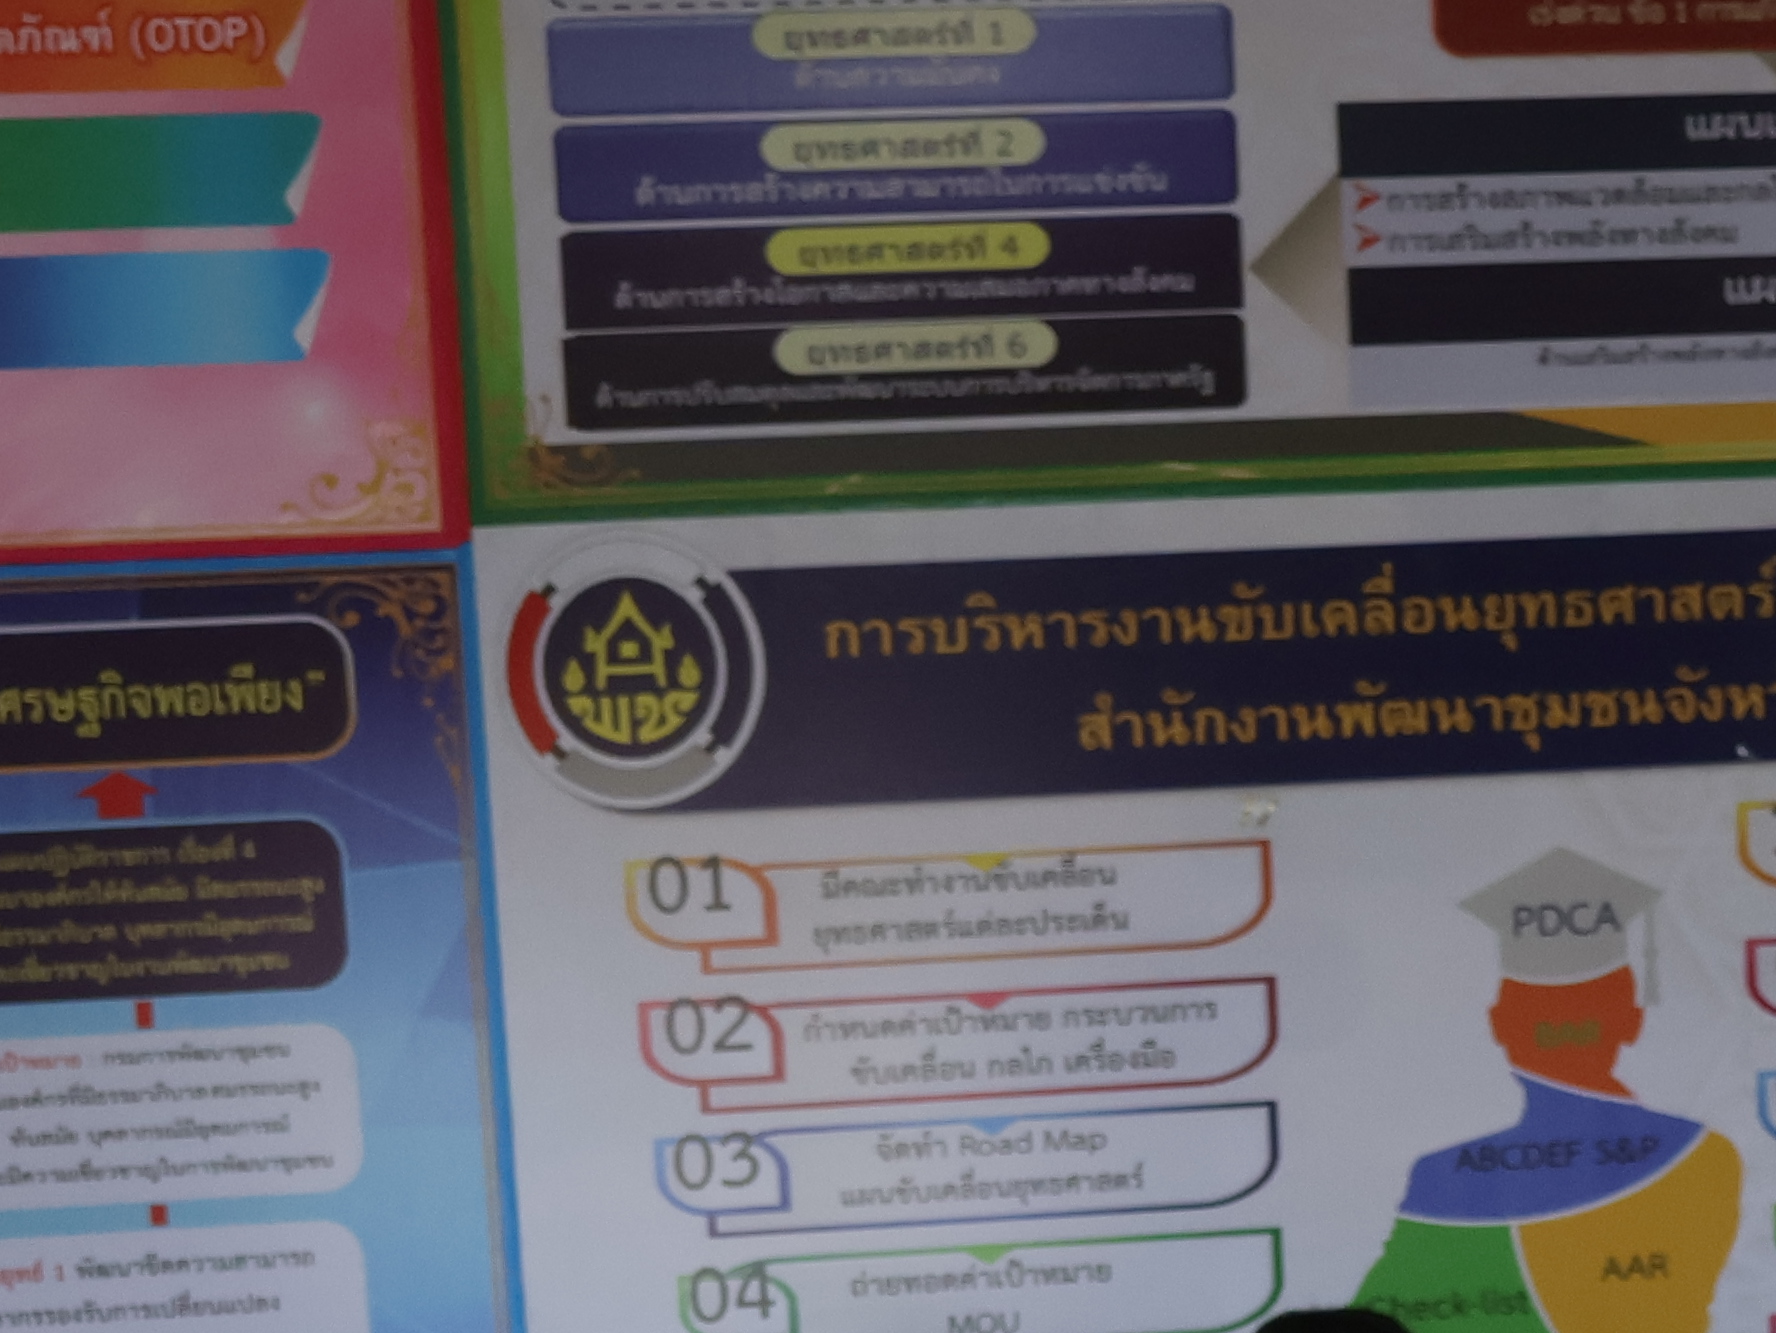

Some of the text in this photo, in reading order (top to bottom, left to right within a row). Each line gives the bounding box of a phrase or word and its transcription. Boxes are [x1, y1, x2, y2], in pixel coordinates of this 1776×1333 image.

[129, 17, 266, 59] (OTOP)
[988, 22, 1005, 47] 1
[996, 130, 1014, 158] 2
[1000, 233, 1019, 259] 4
[1007, 335, 1026, 360] 6
[647, 855, 733, 913] 01
[1511, 903, 1622, 940] PDCA
[664, 997, 754, 1056] 02
[673, 1132, 762, 1192] 03
[960, 1126, 1032, 1158] Road
[1043, 1128, 1108, 1161] Map
[1454, 1137, 1584, 1175] ABCDEF
[1600, 1253, 1670, 1282] AAR
[690, 1265, 776, 1324] 04
